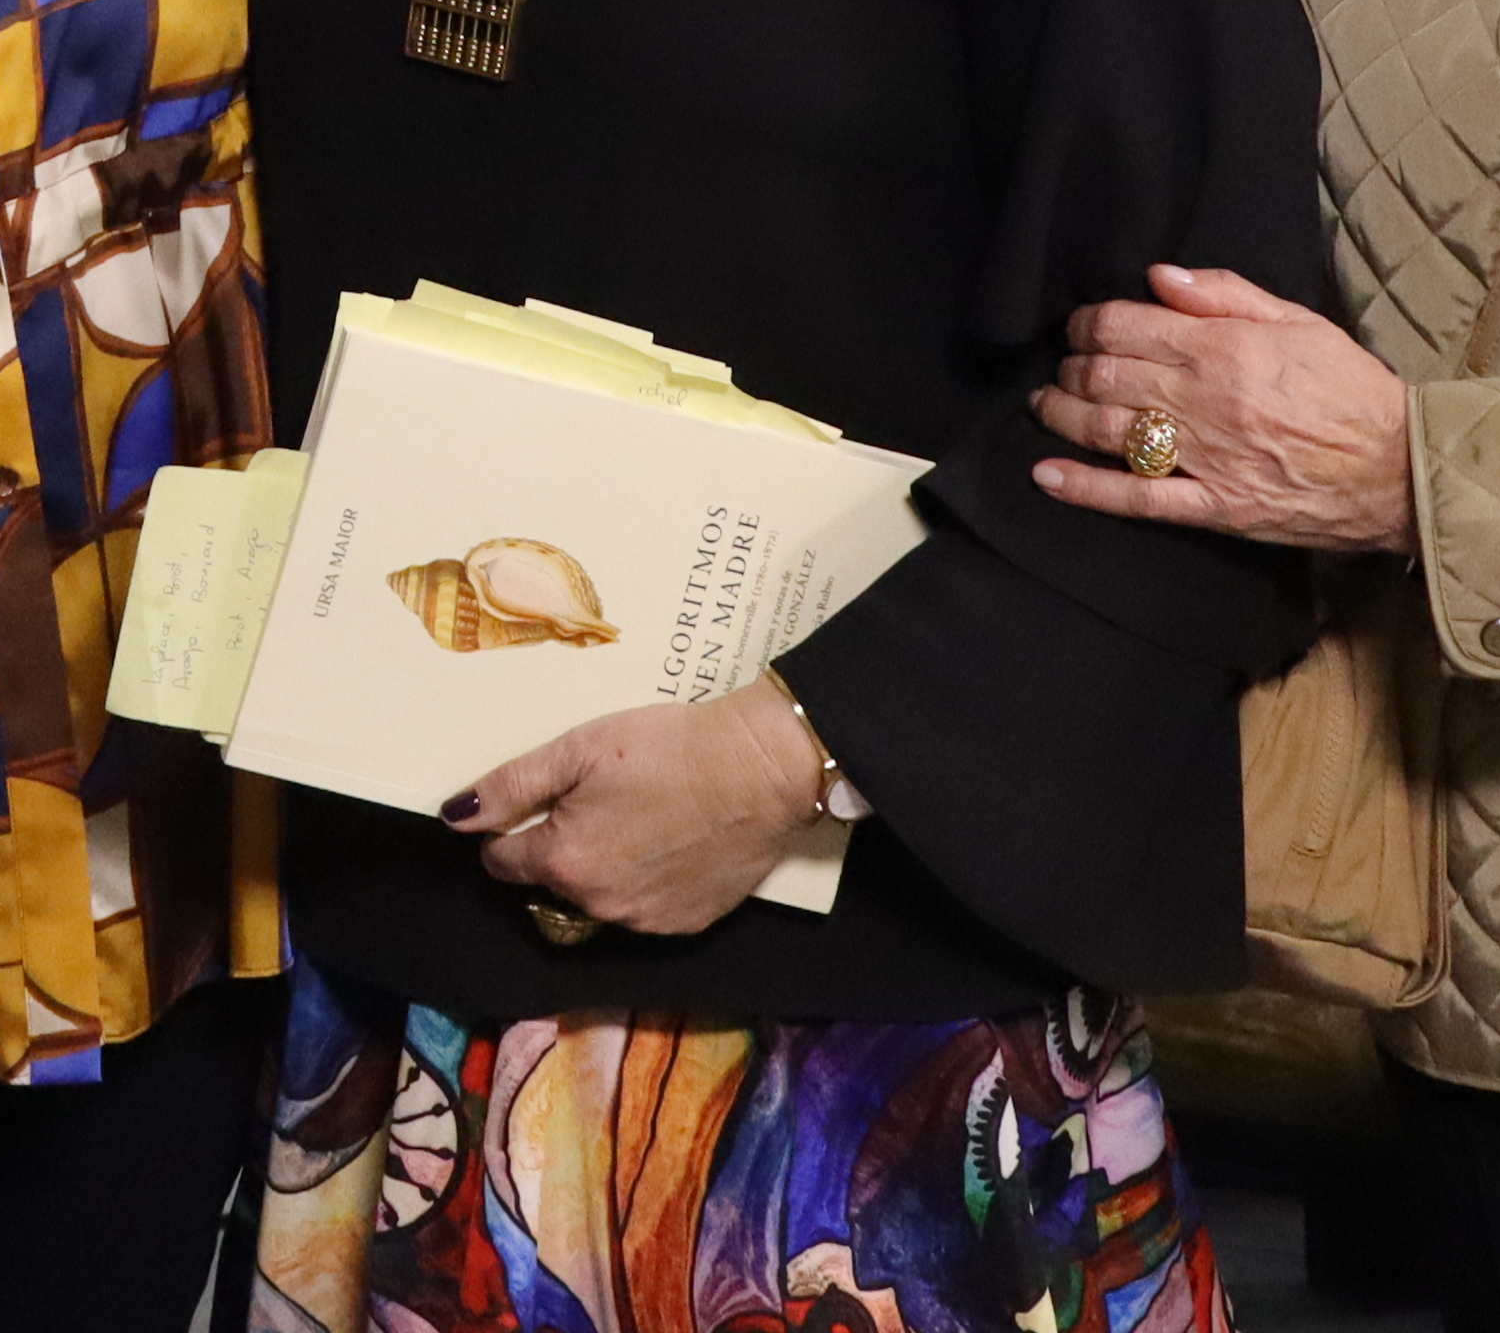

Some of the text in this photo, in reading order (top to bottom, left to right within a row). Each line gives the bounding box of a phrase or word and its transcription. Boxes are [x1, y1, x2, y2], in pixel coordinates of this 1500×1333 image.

[313, 507, 359, 619] URSA MAIOR
[656, 504, 729, 699] LGORITMOS
[710, 512, 761, 630] MADRE
